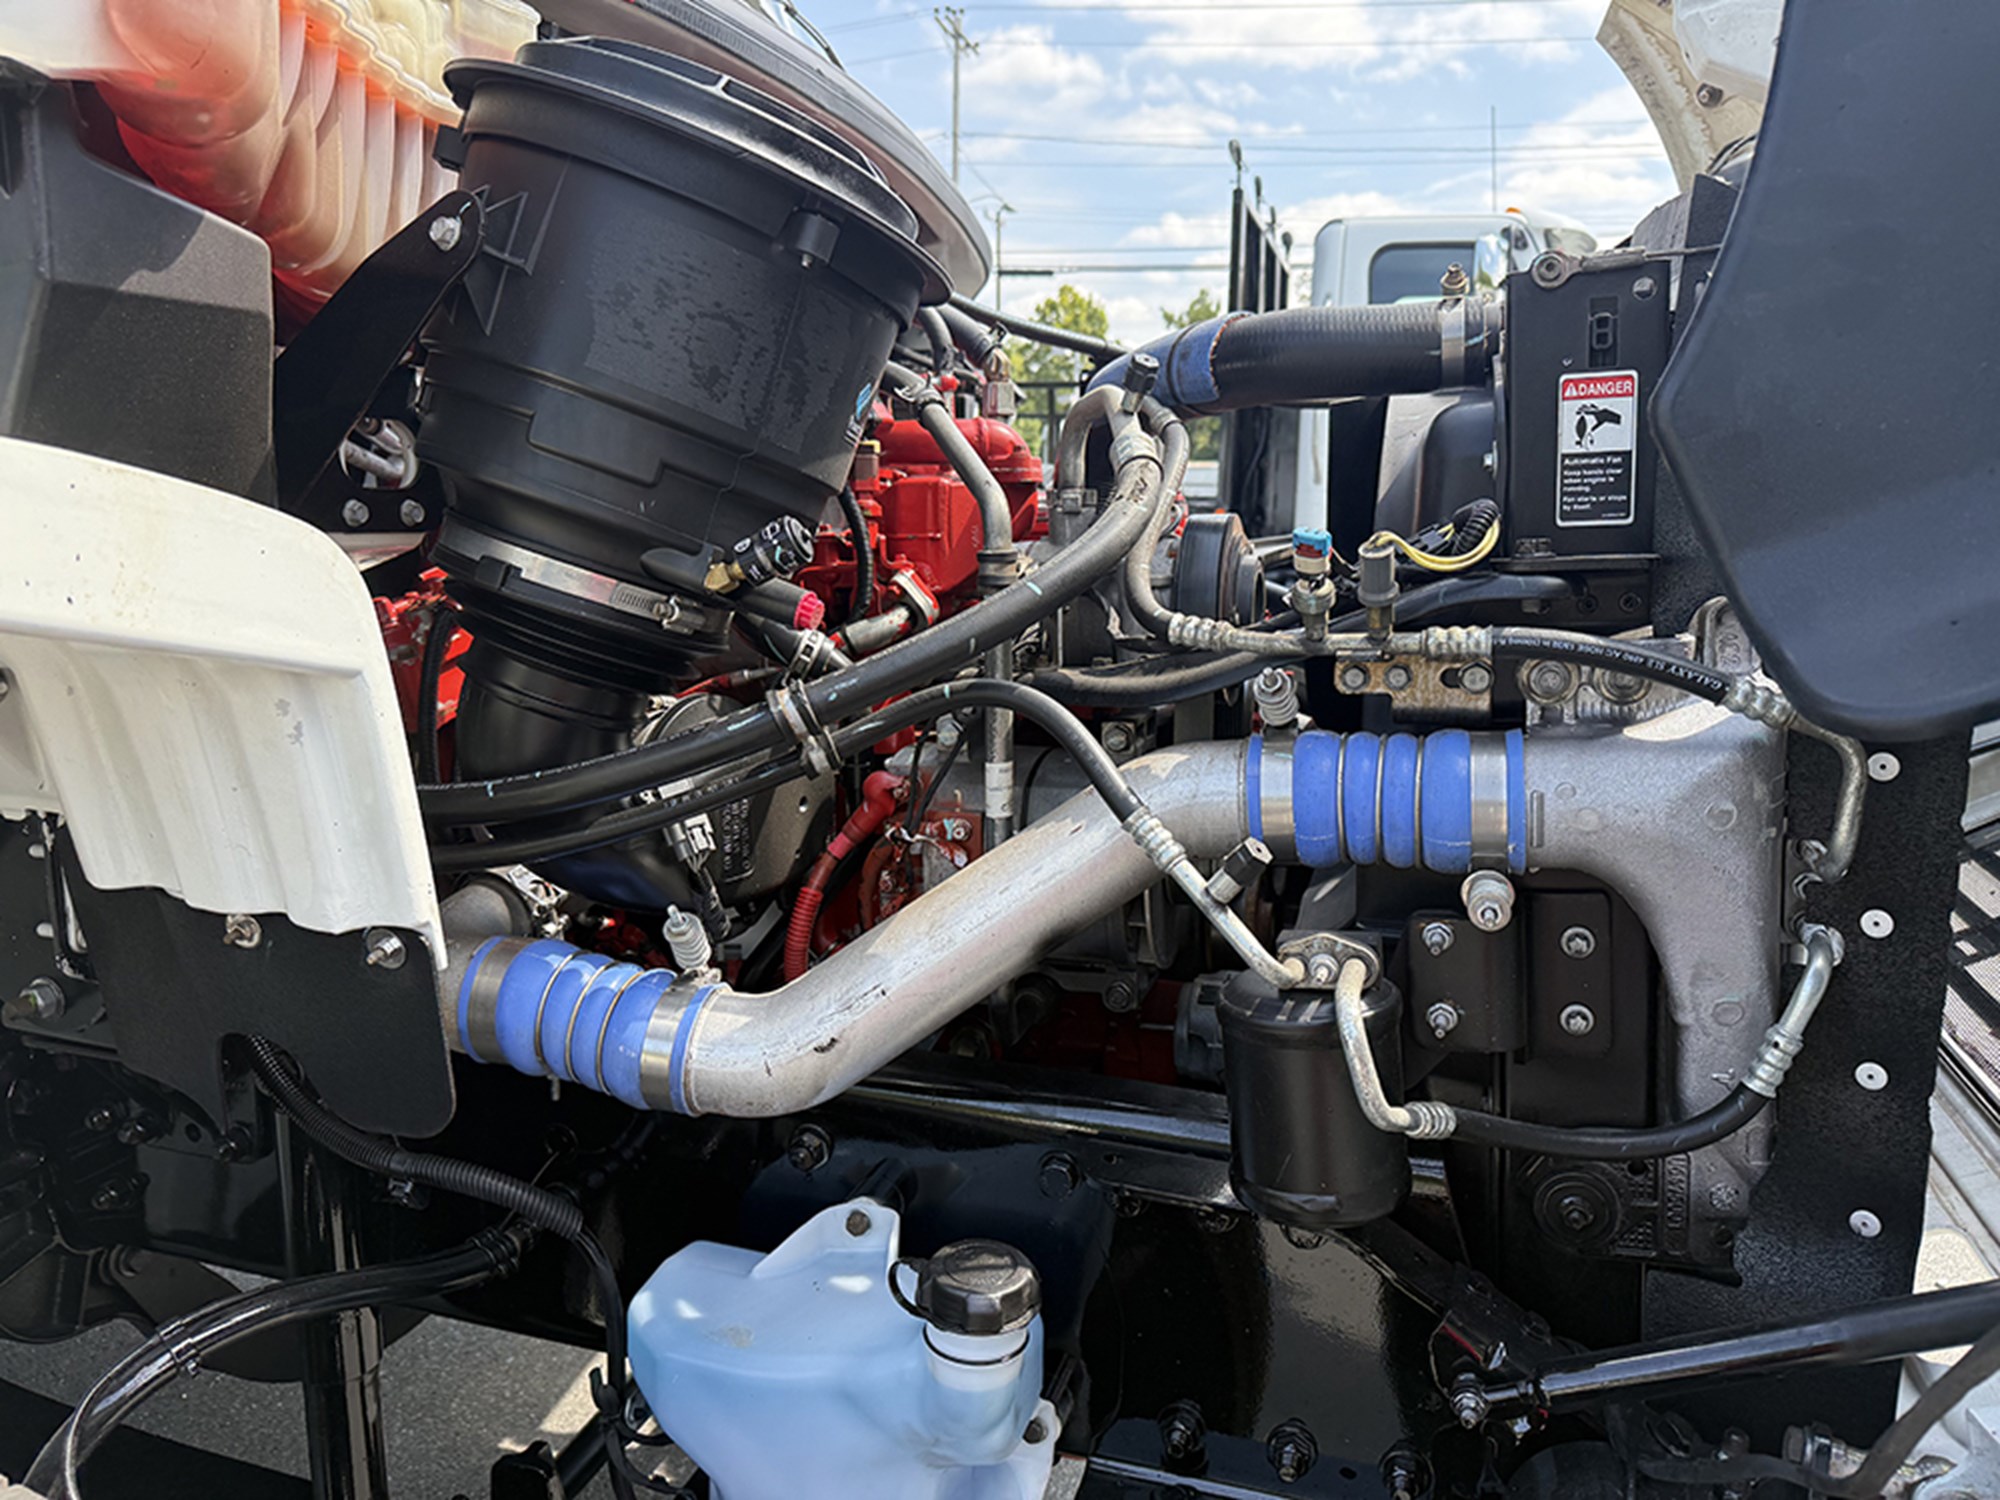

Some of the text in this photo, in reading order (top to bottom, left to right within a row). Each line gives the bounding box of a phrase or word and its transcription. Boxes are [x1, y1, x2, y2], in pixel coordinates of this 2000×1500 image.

[1578, 381, 1633, 397] DANGER
[1563, 455, 1622, 466] Automatic Fan
[1666, 664, 1723, 691] GALAXY
